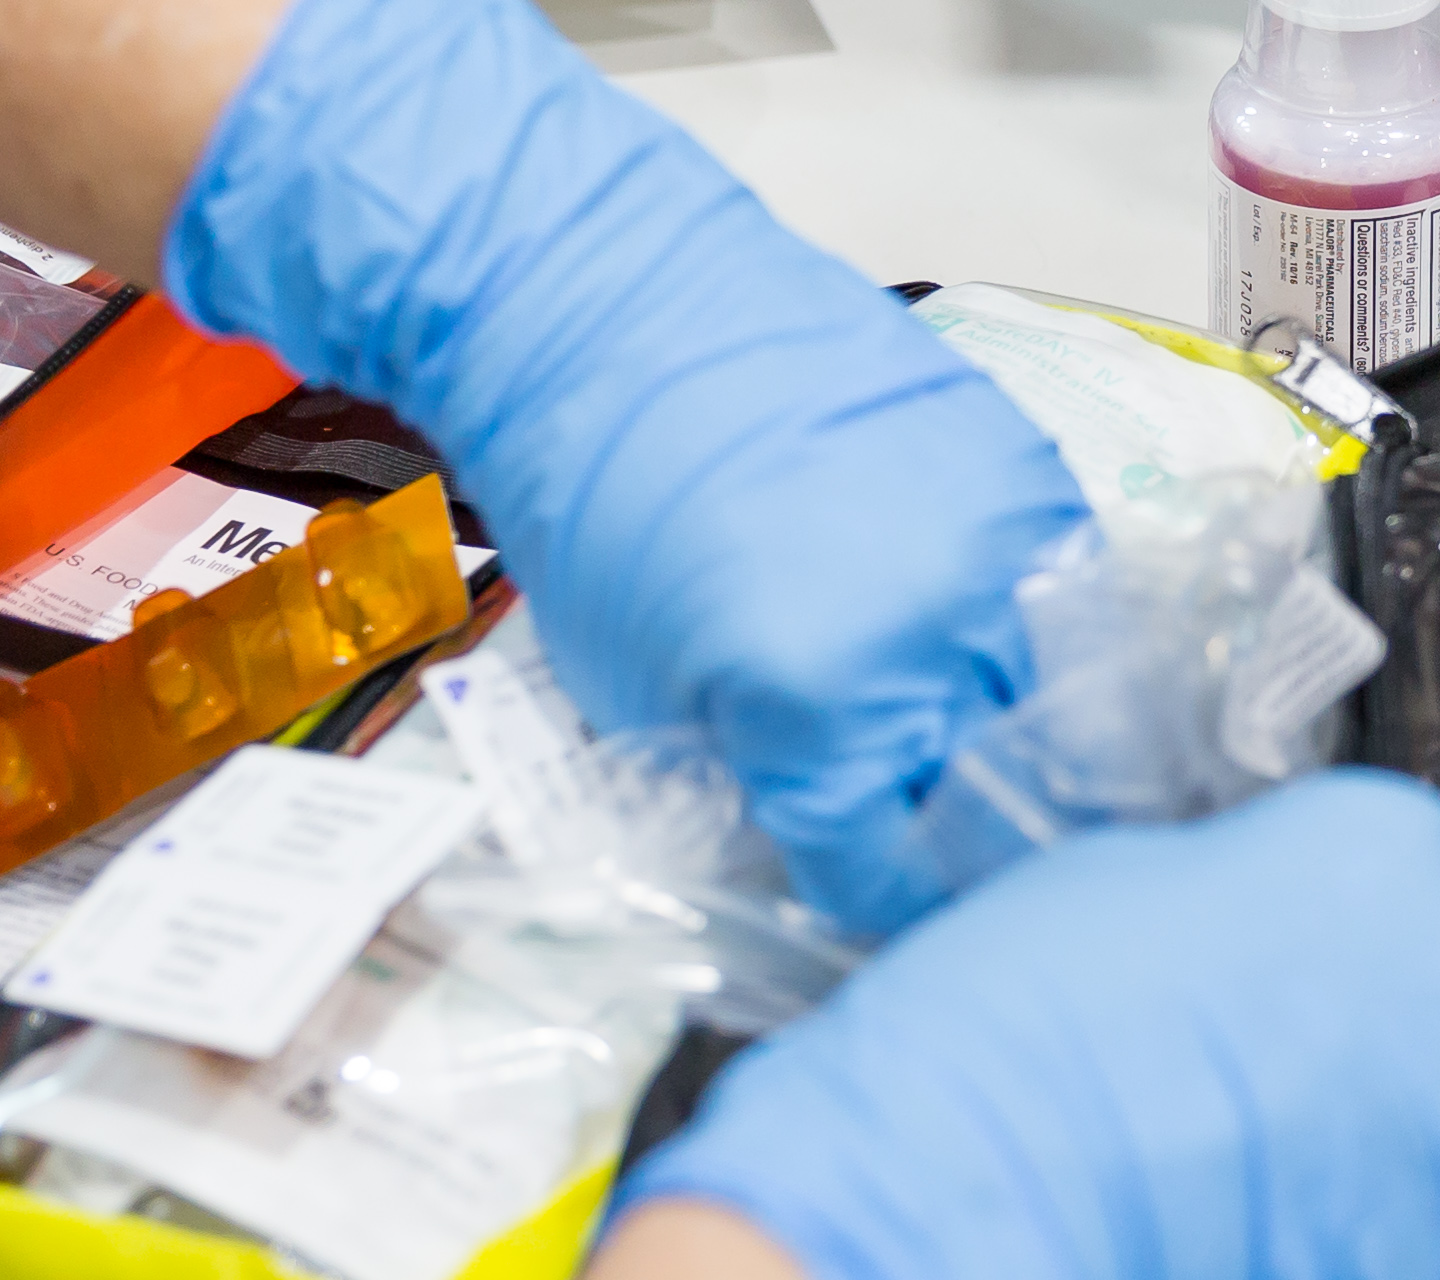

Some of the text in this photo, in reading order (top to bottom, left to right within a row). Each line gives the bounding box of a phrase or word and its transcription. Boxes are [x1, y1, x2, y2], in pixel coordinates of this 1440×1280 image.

[1326, 258, 1334, 342] PHARMACEUTICALS
[1356, 224, 1370, 352] Questions or comments?
[1404, 218, 1418, 333] Inactive ingredients
[91, 565, 158, 595] FOOD
[200, 519, 292, 565] Me
